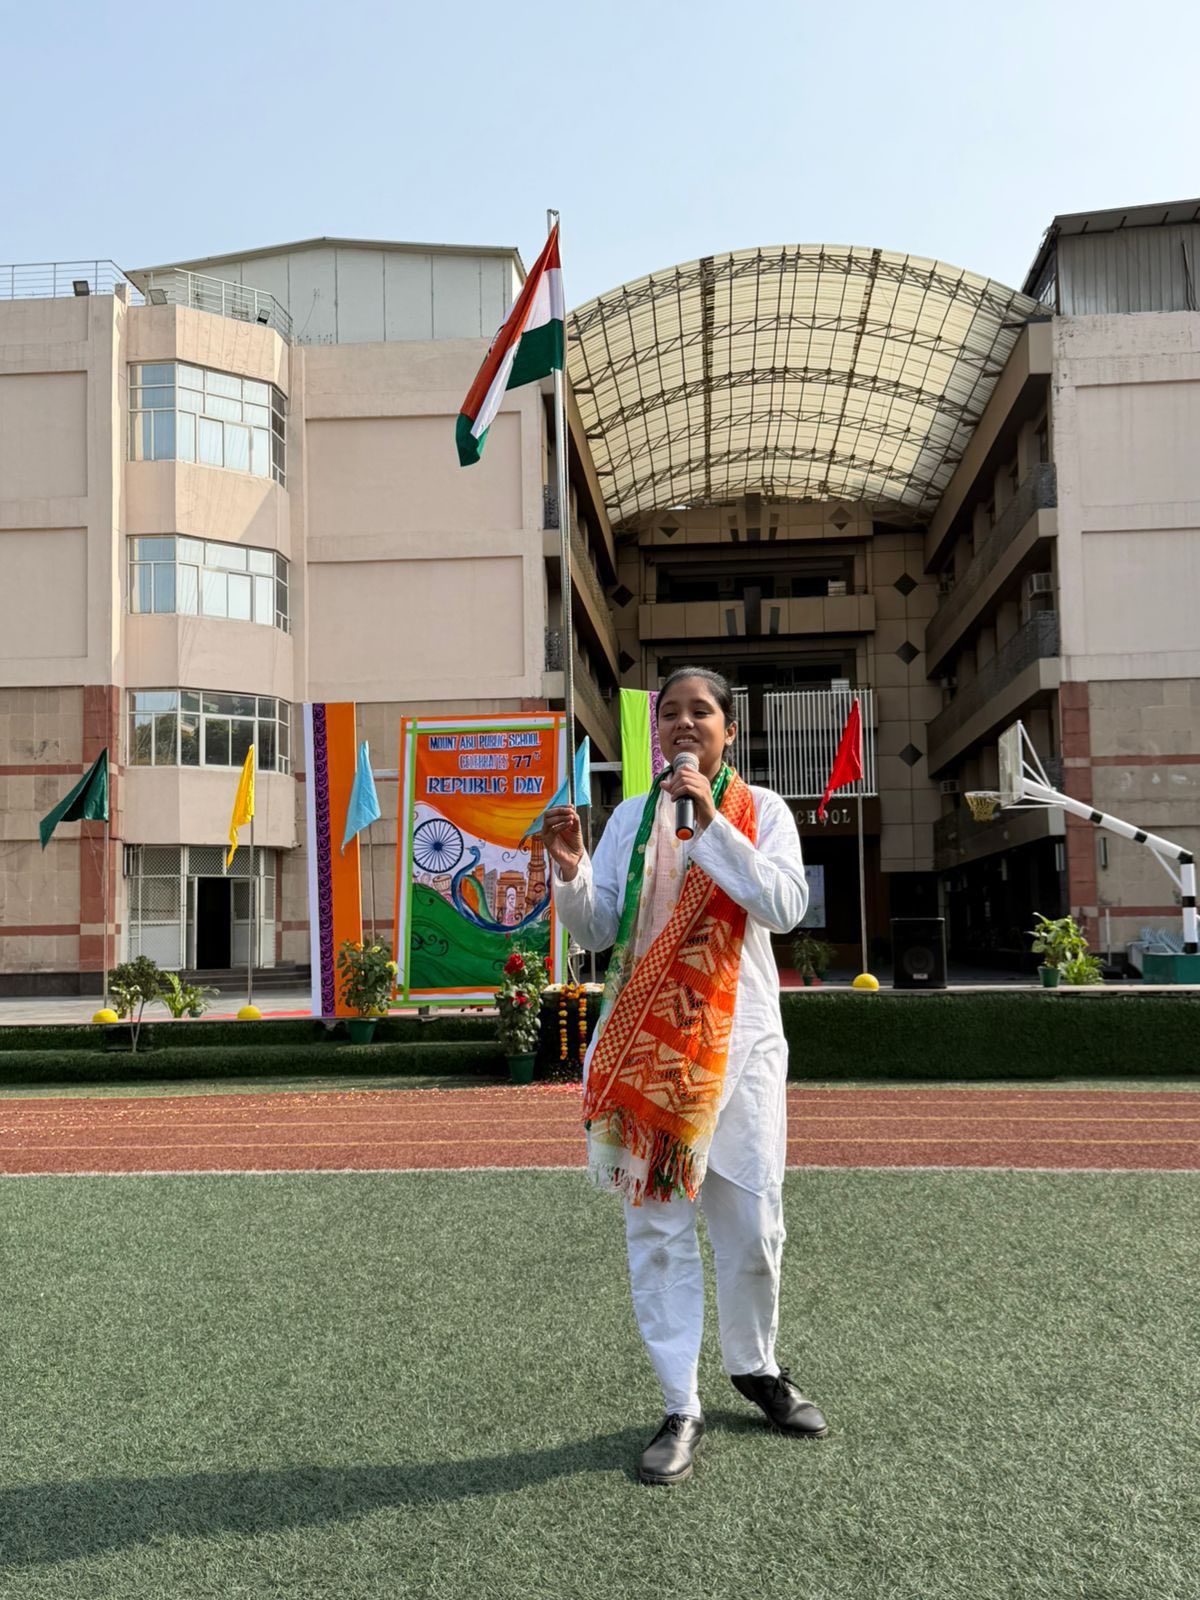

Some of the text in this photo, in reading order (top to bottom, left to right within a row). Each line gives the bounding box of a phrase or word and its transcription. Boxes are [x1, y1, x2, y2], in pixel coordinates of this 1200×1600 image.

[429, 731, 540, 751] MOUNT ABU PUBLIC SCHOOL
[427, 776, 544, 794] REPUBLIC DAY
[796, 808, 851, 825] CHOL
